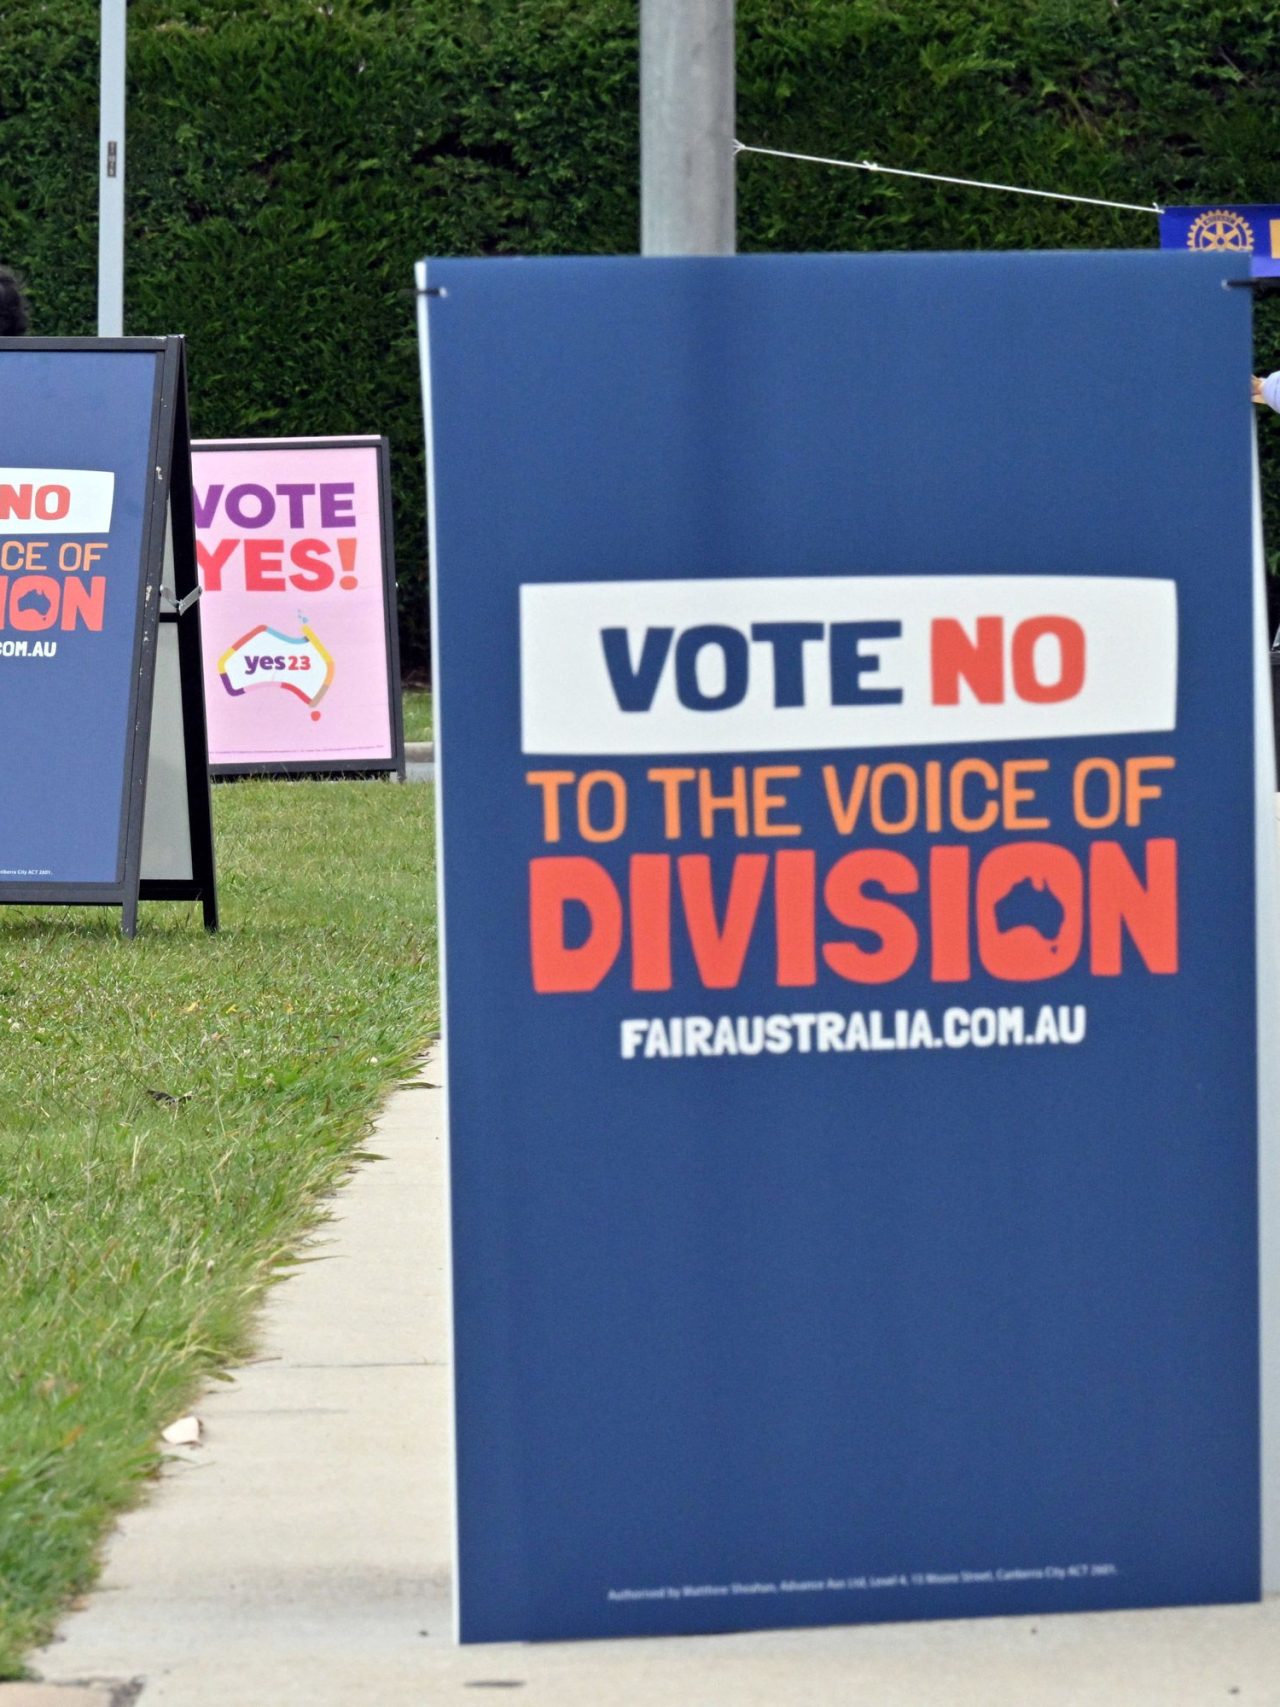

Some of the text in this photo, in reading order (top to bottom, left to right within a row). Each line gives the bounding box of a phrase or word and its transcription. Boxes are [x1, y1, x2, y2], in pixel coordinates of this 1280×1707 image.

[193, 482, 356, 529] VOTE
[59, 543, 108, 571] OF
[195, 538, 358, 592] YES!
[244, 655, 311, 675] yes23
[600, 615, 1086, 712] VOTE NO
[526, 756, 1176, 842] TO THE VOICE OF
[529, 837, 1178, 994] DIVISION
[621, 1005, 1086, 1059] FAIRAUSTRALIA.COM.AU
